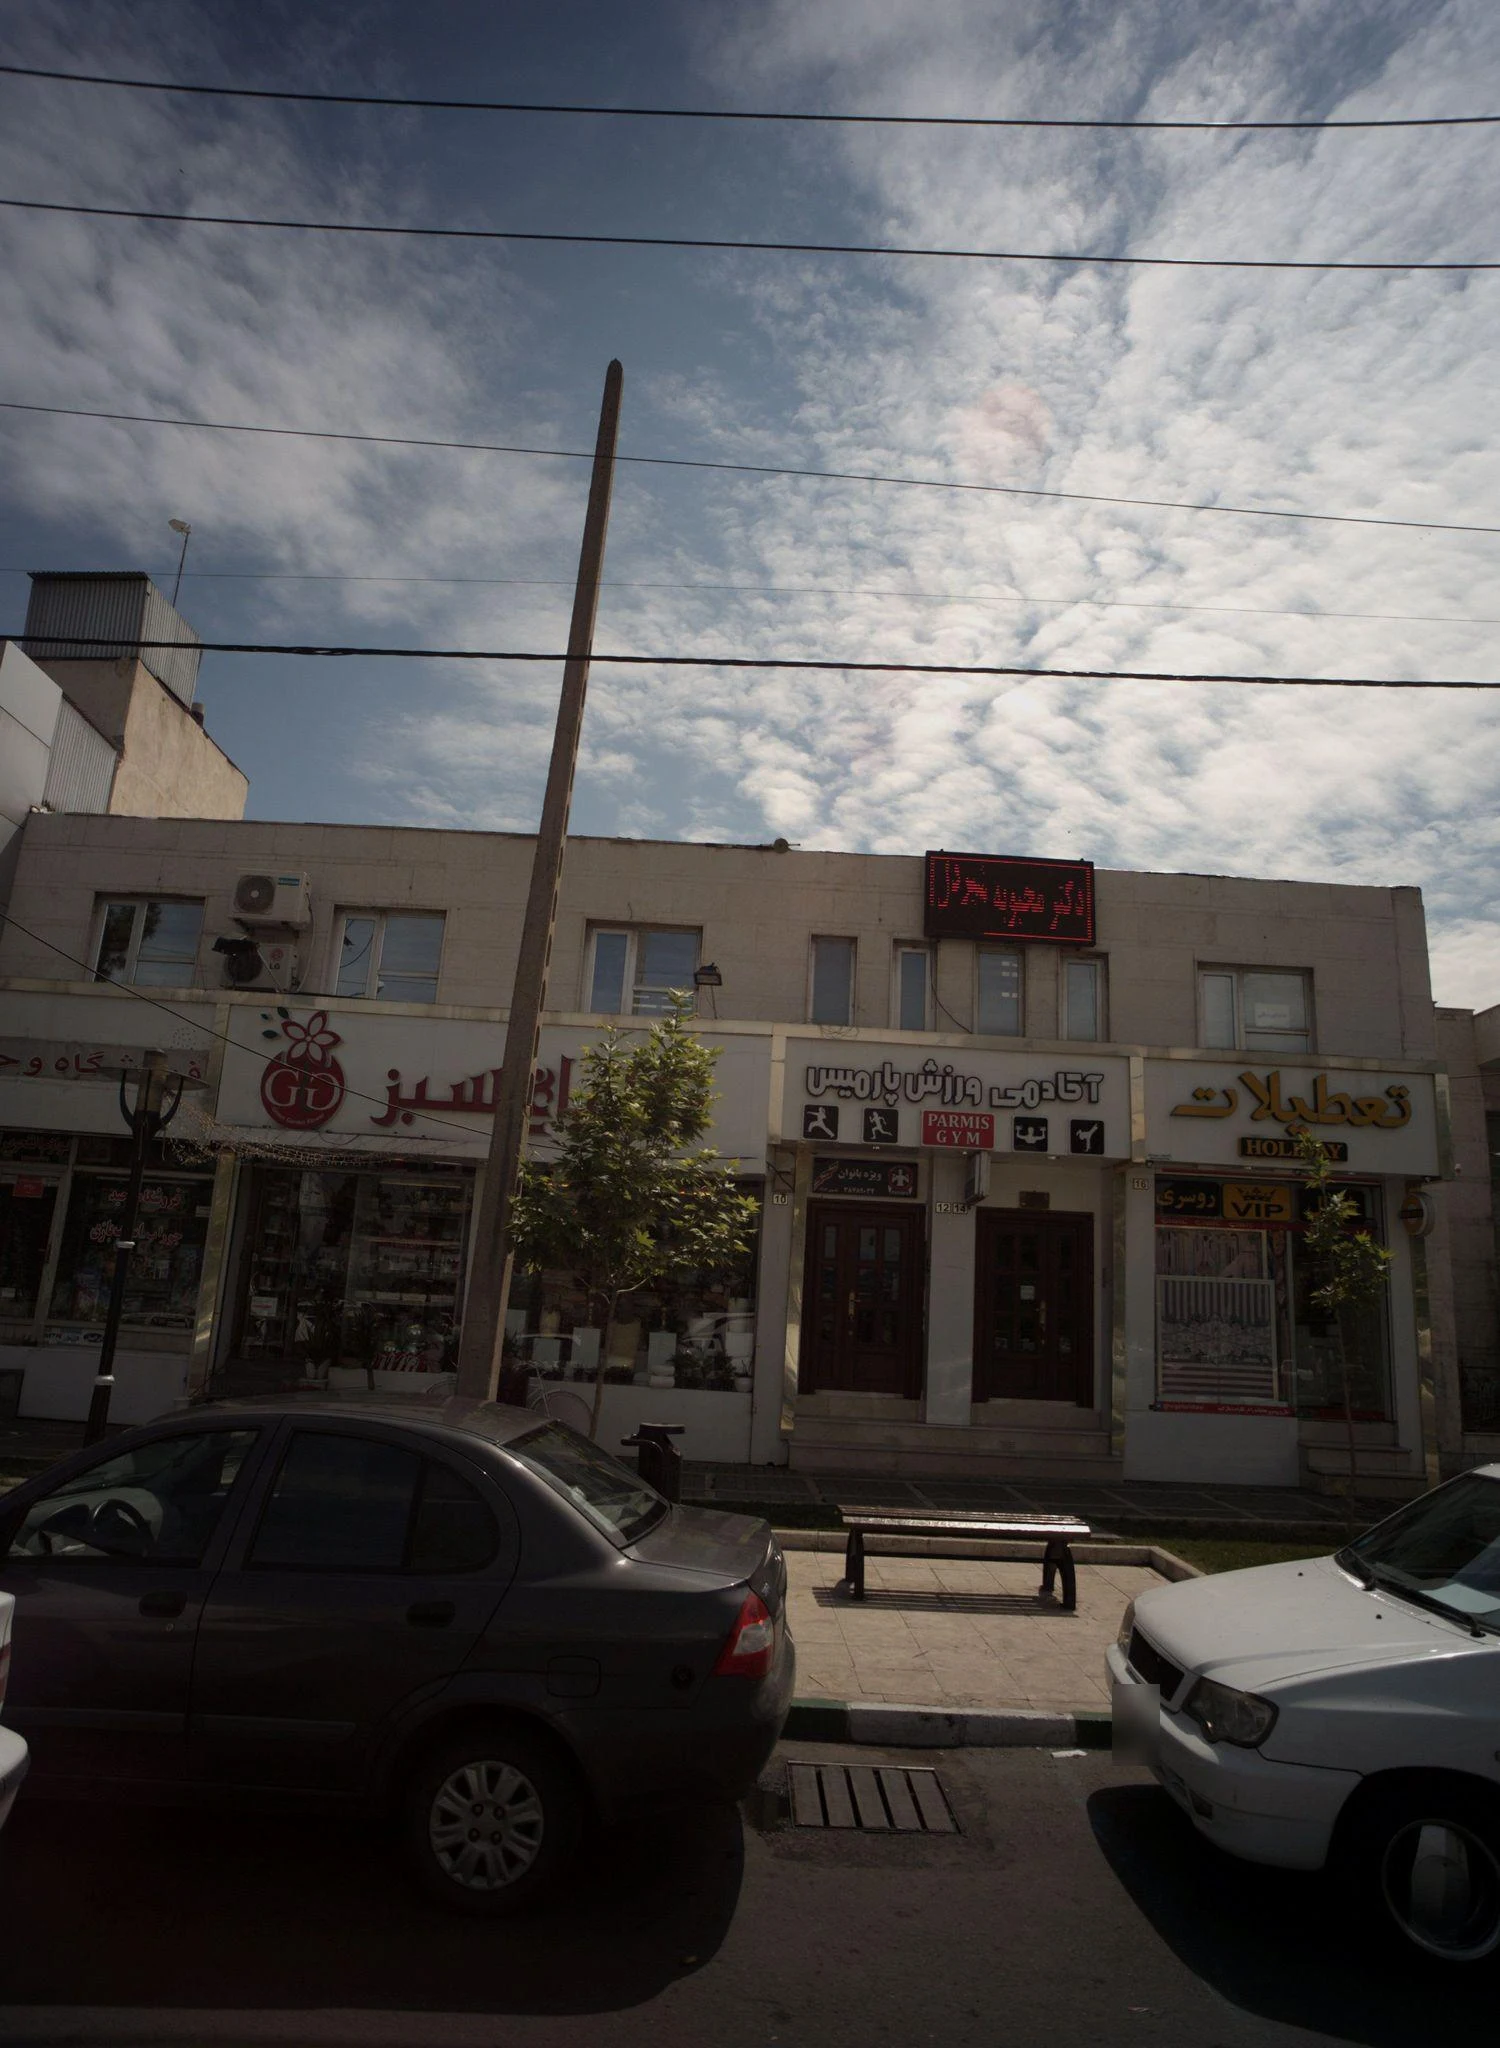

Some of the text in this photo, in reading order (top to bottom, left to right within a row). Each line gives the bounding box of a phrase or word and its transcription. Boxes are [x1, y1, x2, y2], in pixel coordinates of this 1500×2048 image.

[269, 961, 281, 970] LG
[806, 1058, 1105, 1109] آکادمی ورزش پارمیس
[1170, 1070, 1412, 1136] تعطیلات
[928, 1113, 991, 1130] PARMIS
[936, 1129, 981, 1146] GYM
[838, 1167, 862, 1180] بانوان
[863, 1169, 883, 1182] ویژه
[775, 1195, 787, 1204] 10
[1156, 1187, 1216, 1208] روسری
[938, 1203, 949, 1212] 12
[1231, 1202, 1284, 1218] VIP
